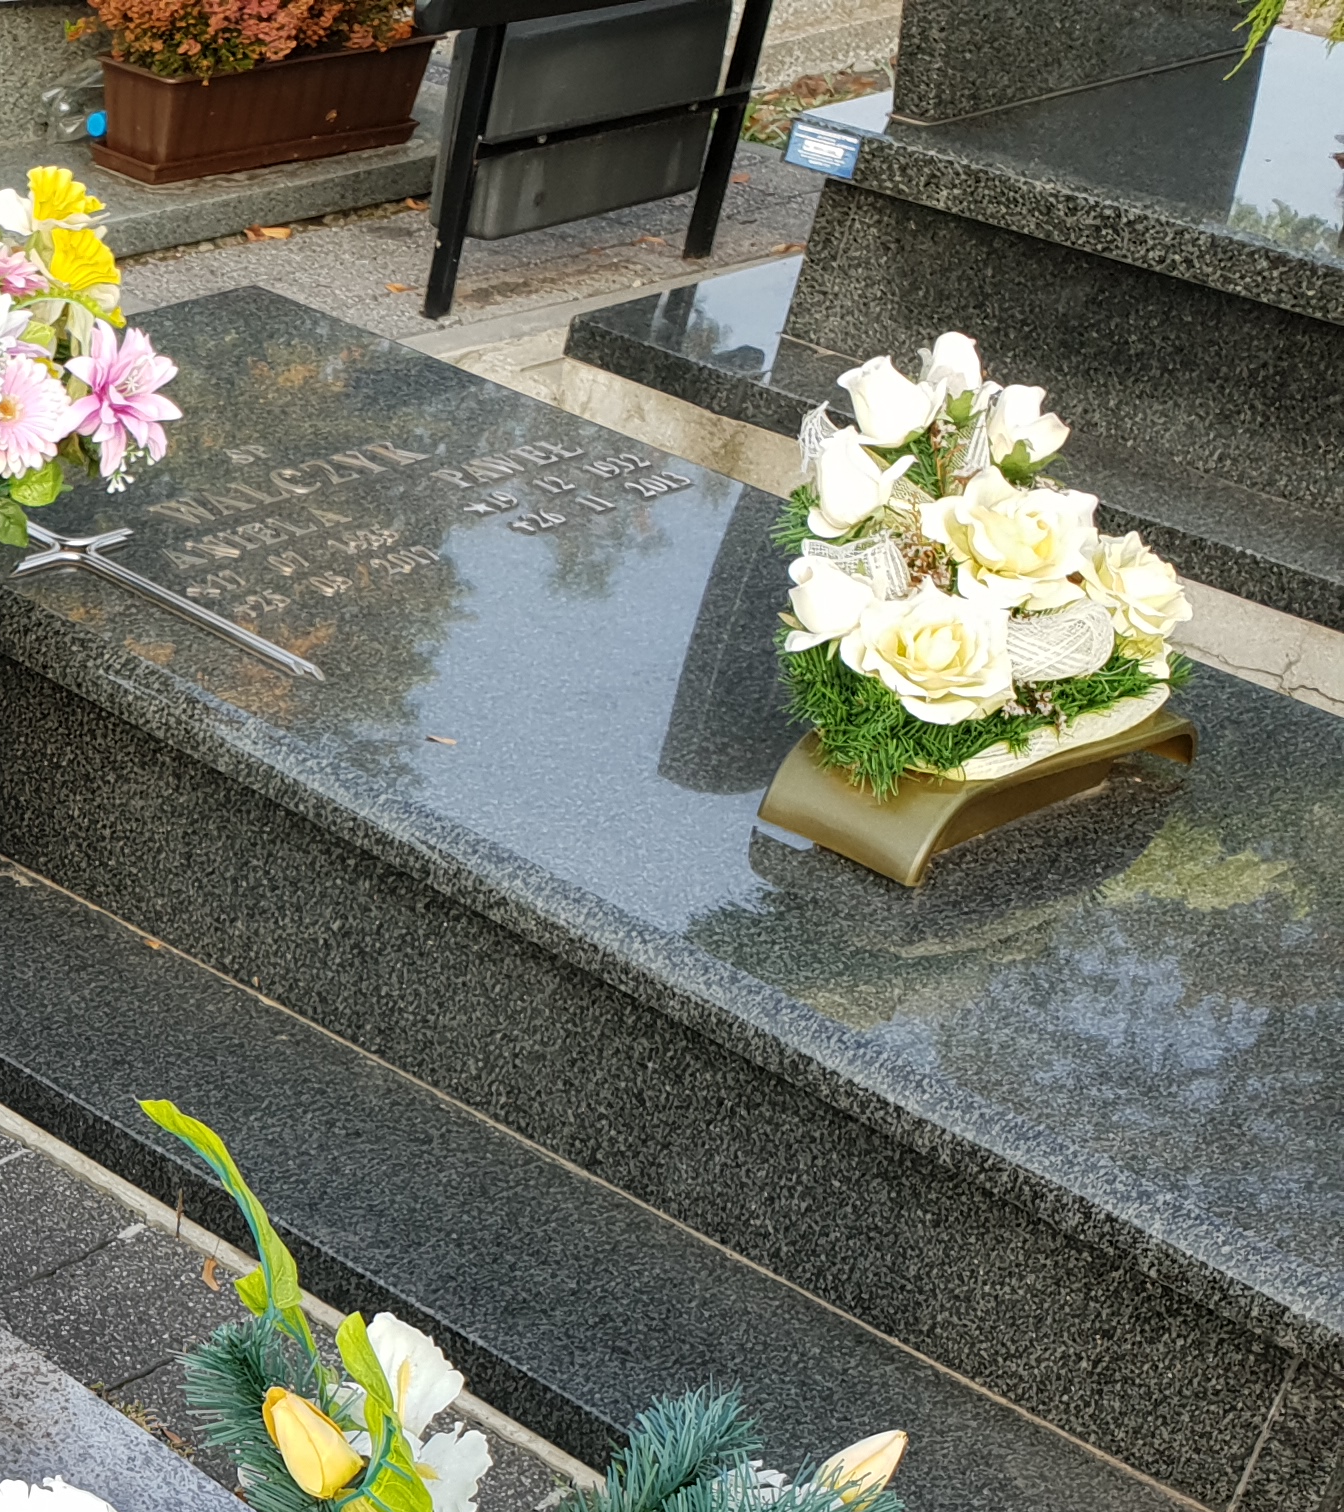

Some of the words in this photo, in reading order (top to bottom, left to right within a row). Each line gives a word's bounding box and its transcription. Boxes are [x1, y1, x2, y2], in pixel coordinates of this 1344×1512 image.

[147, 442, 432, 524] WALCZYK
[430, 441, 584, 488] PAWEŁ
[533, 476, 575, 493] 12
[583, 453, 652, 478] 1932
[576, 494, 616, 513] 11
[625, 472, 691, 497] 2013
[162, 507, 352, 569] ANIELA
[370, 545, 440, 577] 2017
